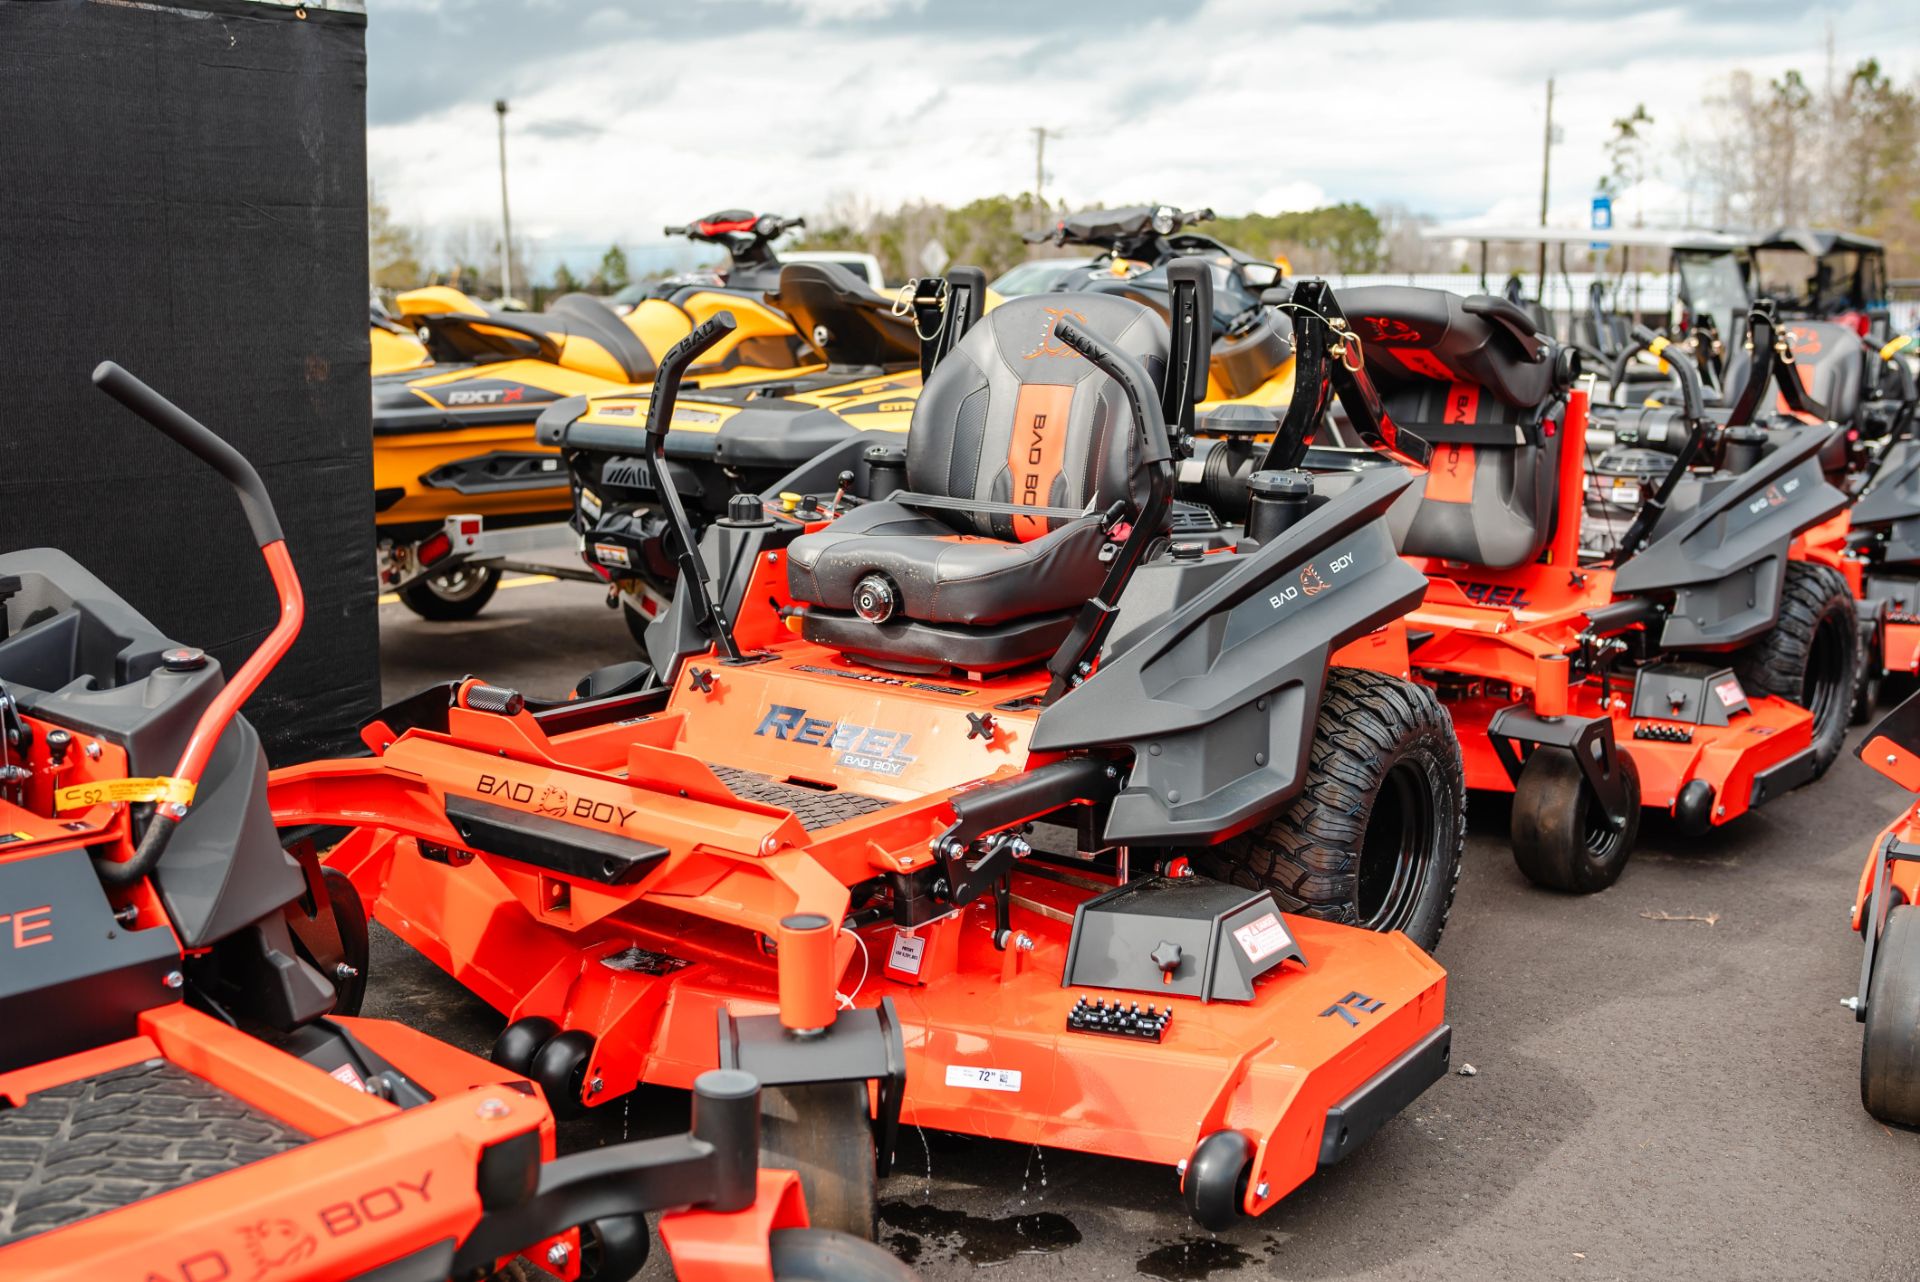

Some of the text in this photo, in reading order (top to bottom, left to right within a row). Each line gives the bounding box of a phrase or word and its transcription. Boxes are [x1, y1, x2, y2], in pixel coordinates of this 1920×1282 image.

[448, 389, 503, 405] RXT
[1454, 395, 1469, 424] BA
[1029, 413, 1047, 465] BAD
[1269, 552, 1354, 609] BAD BOY
[844, 755, 902, 774] BAD BOY
[477, 774, 637, 827] BAD BOY
[1317, 991, 1386, 1028] 72
[318, 1169, 433, 1238] BOY
